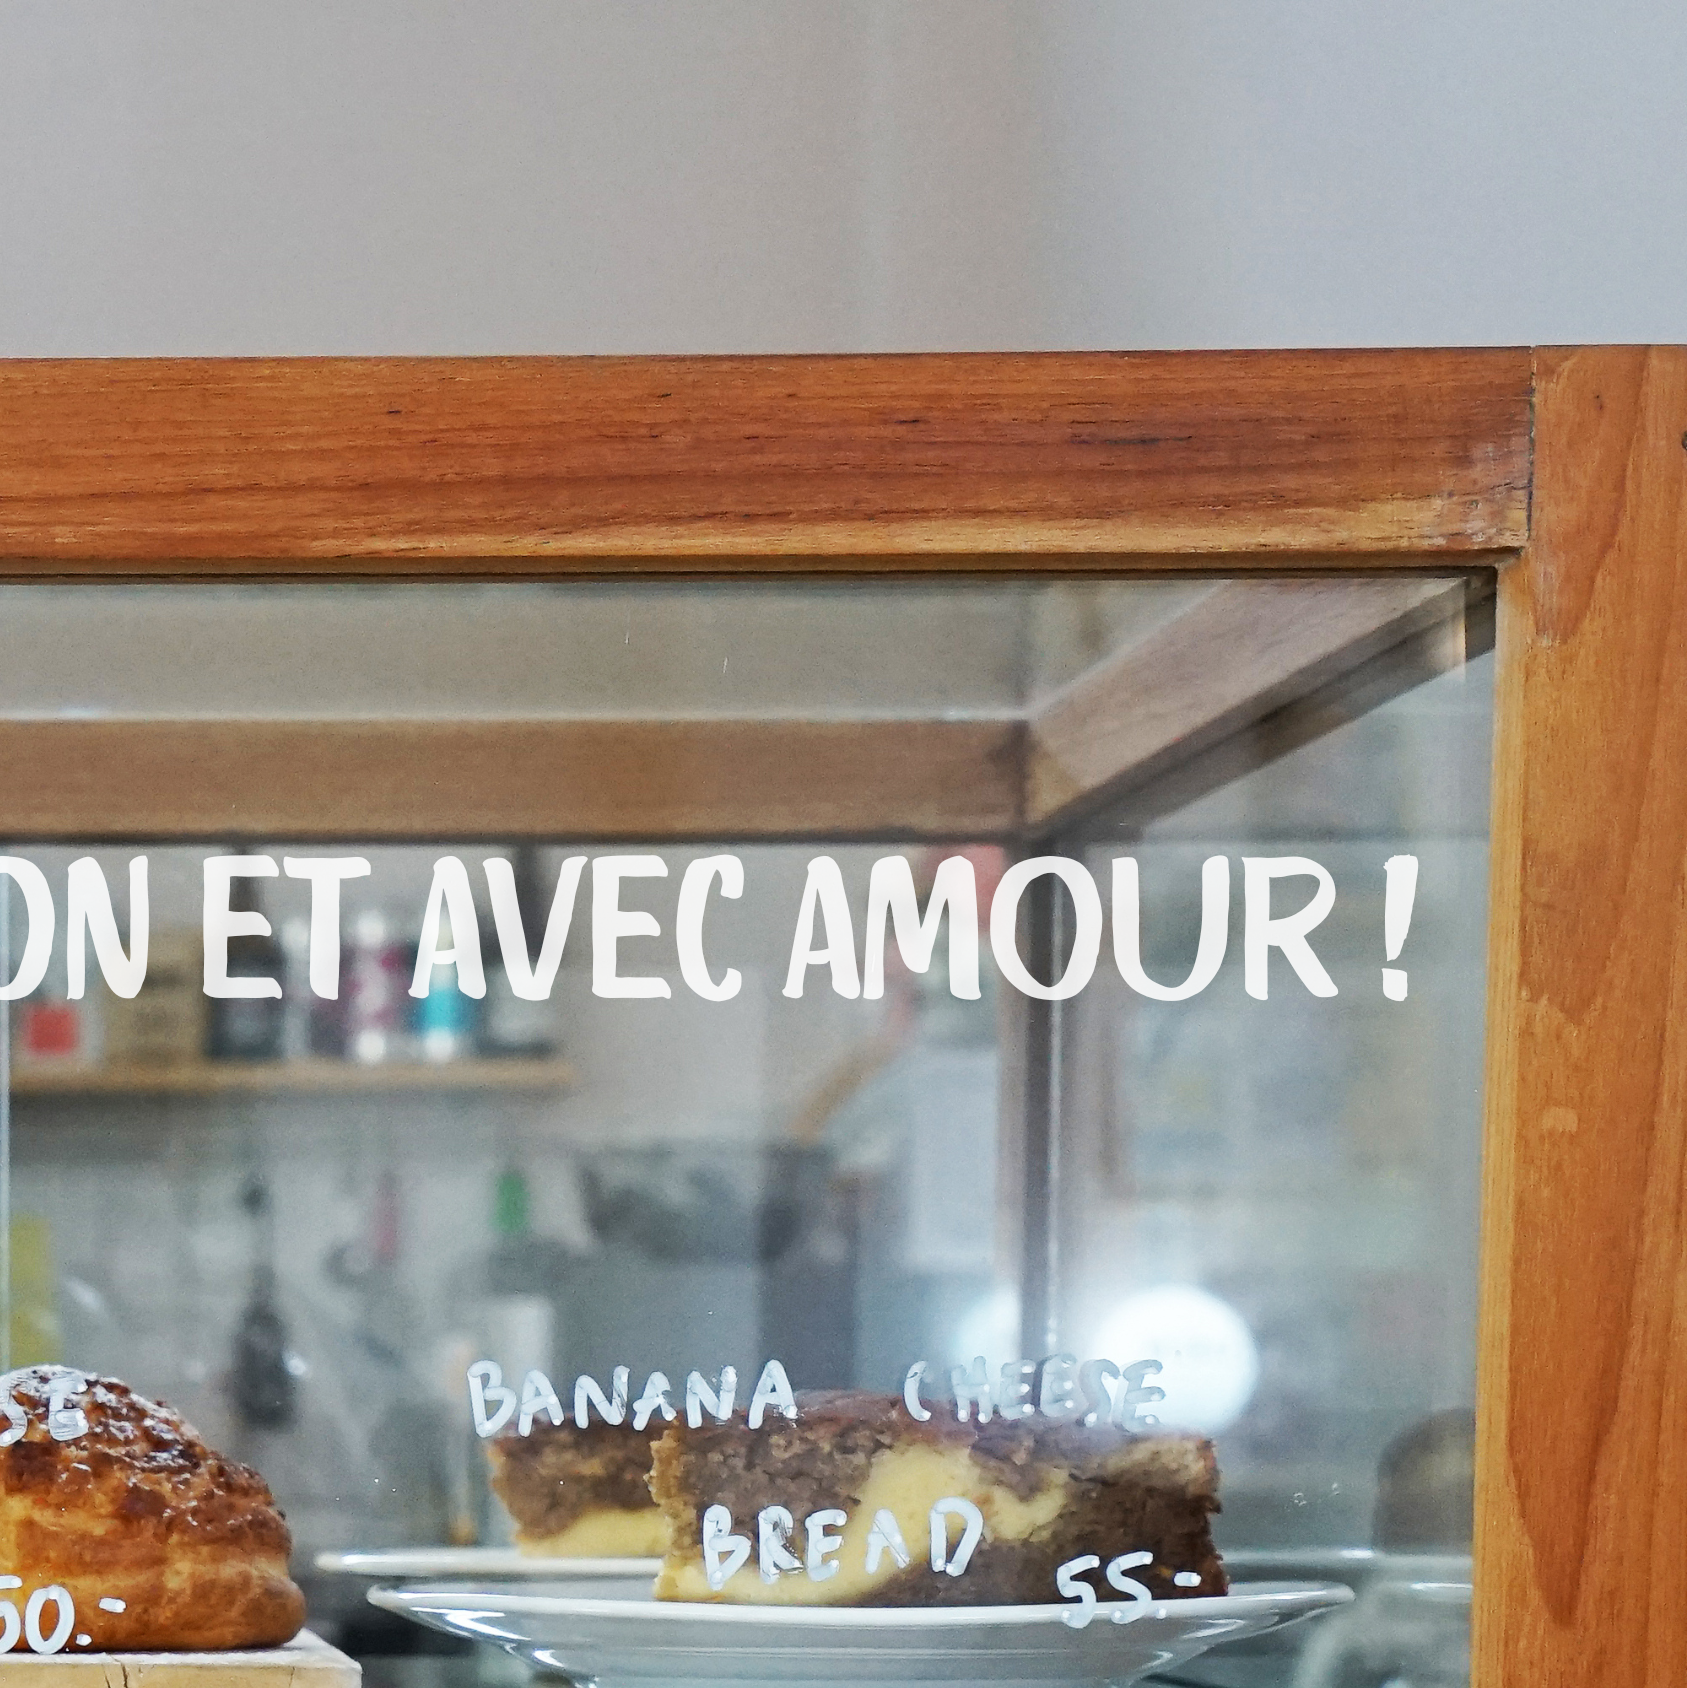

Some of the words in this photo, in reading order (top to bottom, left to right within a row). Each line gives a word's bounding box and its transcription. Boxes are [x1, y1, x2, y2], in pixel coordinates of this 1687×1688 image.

[202, 855, 372, 1001] ET
[408, 855, 745, 1002] AVEC
[782, 855, 1339, 1002] AMOUR
[466, 1359, 800, 1439] BANANA
[903, 1354, 1167, 1433] CHEESE
[702, 1496, 985, 1592] BREAD
